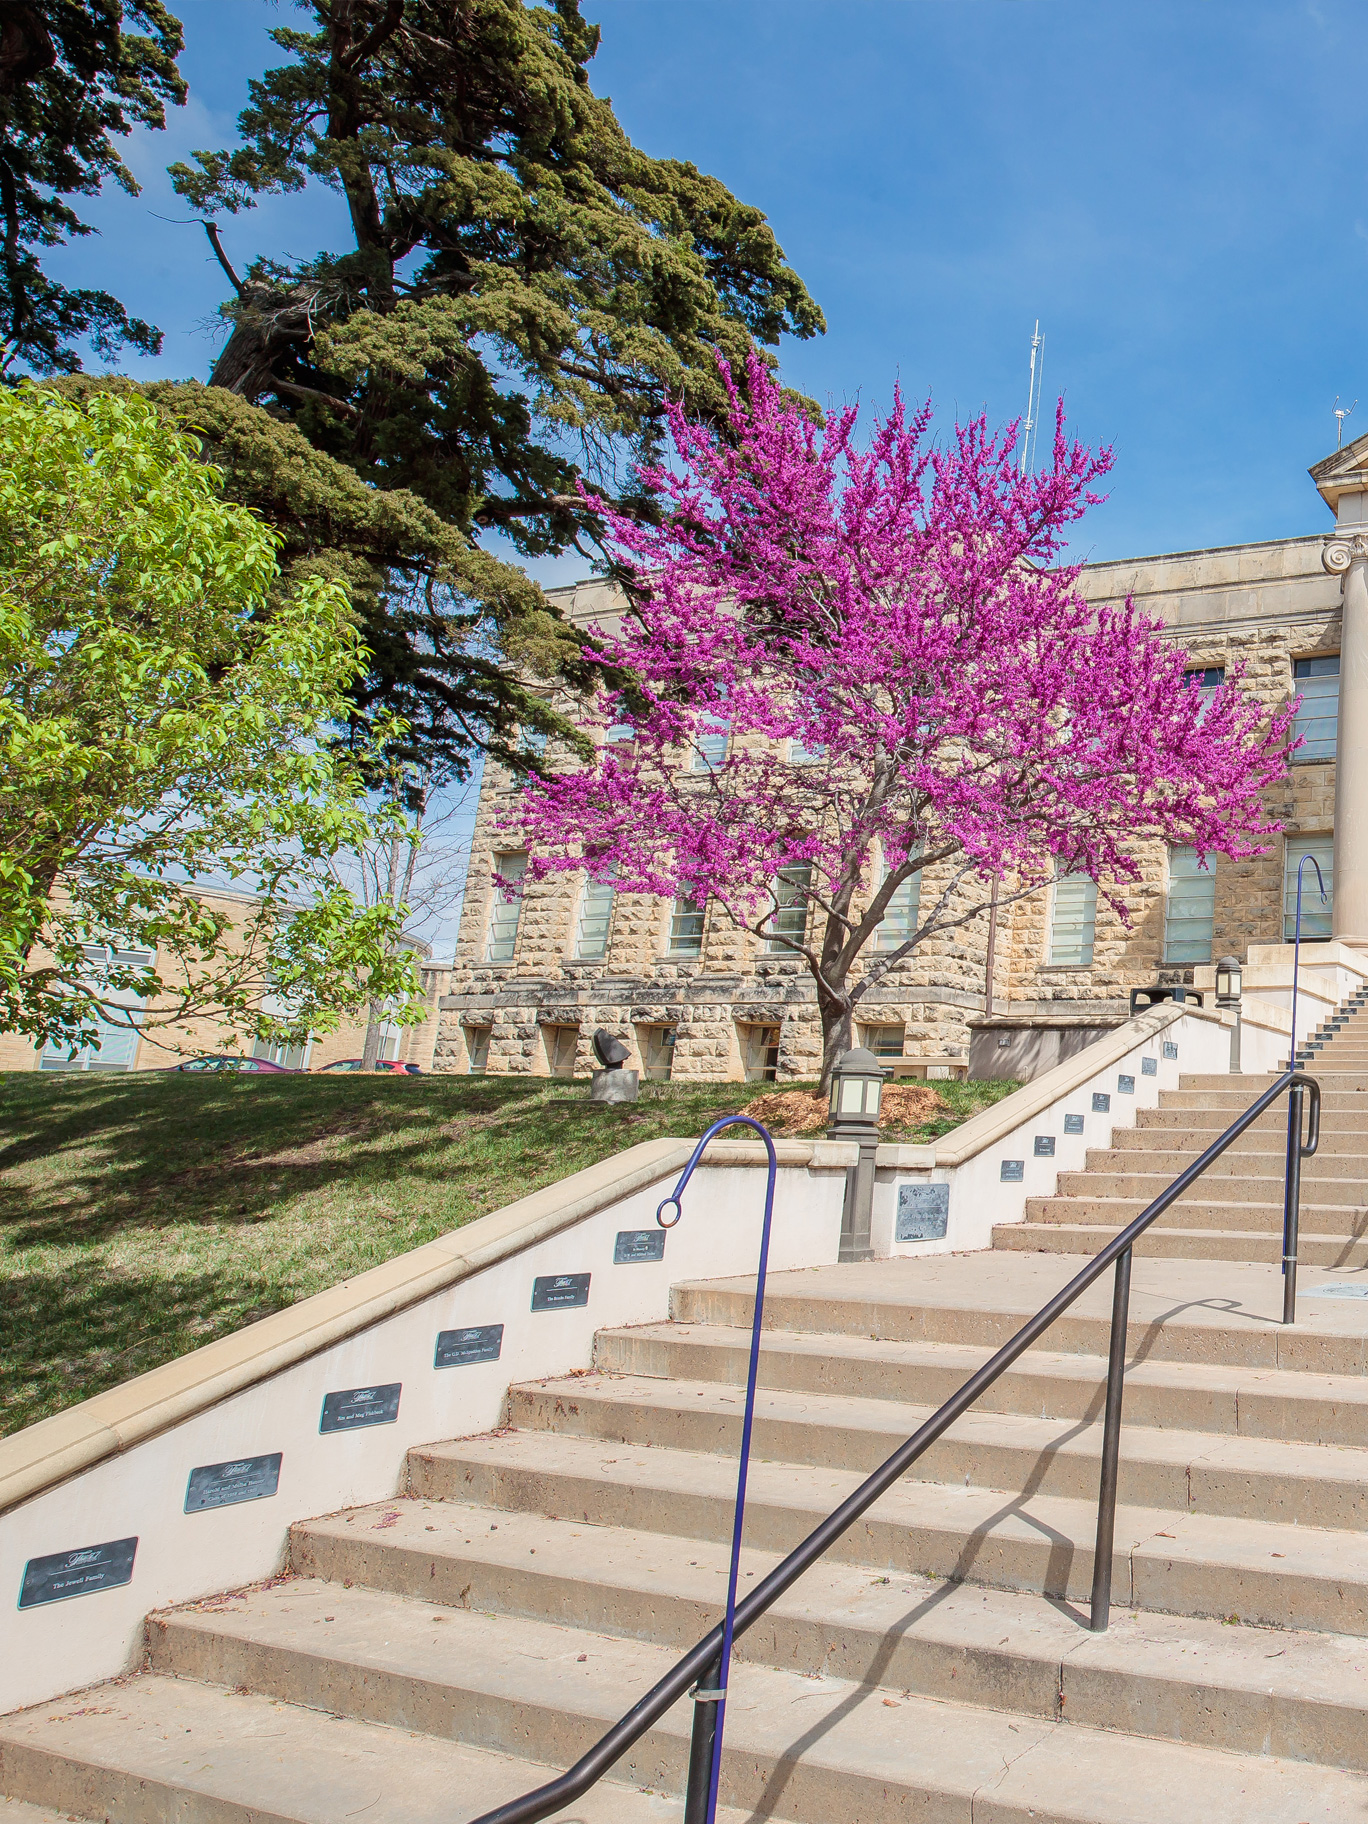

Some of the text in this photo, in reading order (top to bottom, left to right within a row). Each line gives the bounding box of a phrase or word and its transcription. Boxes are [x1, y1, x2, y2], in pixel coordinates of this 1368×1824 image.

[53, 1572, 106, 1590] The Jewell Family
